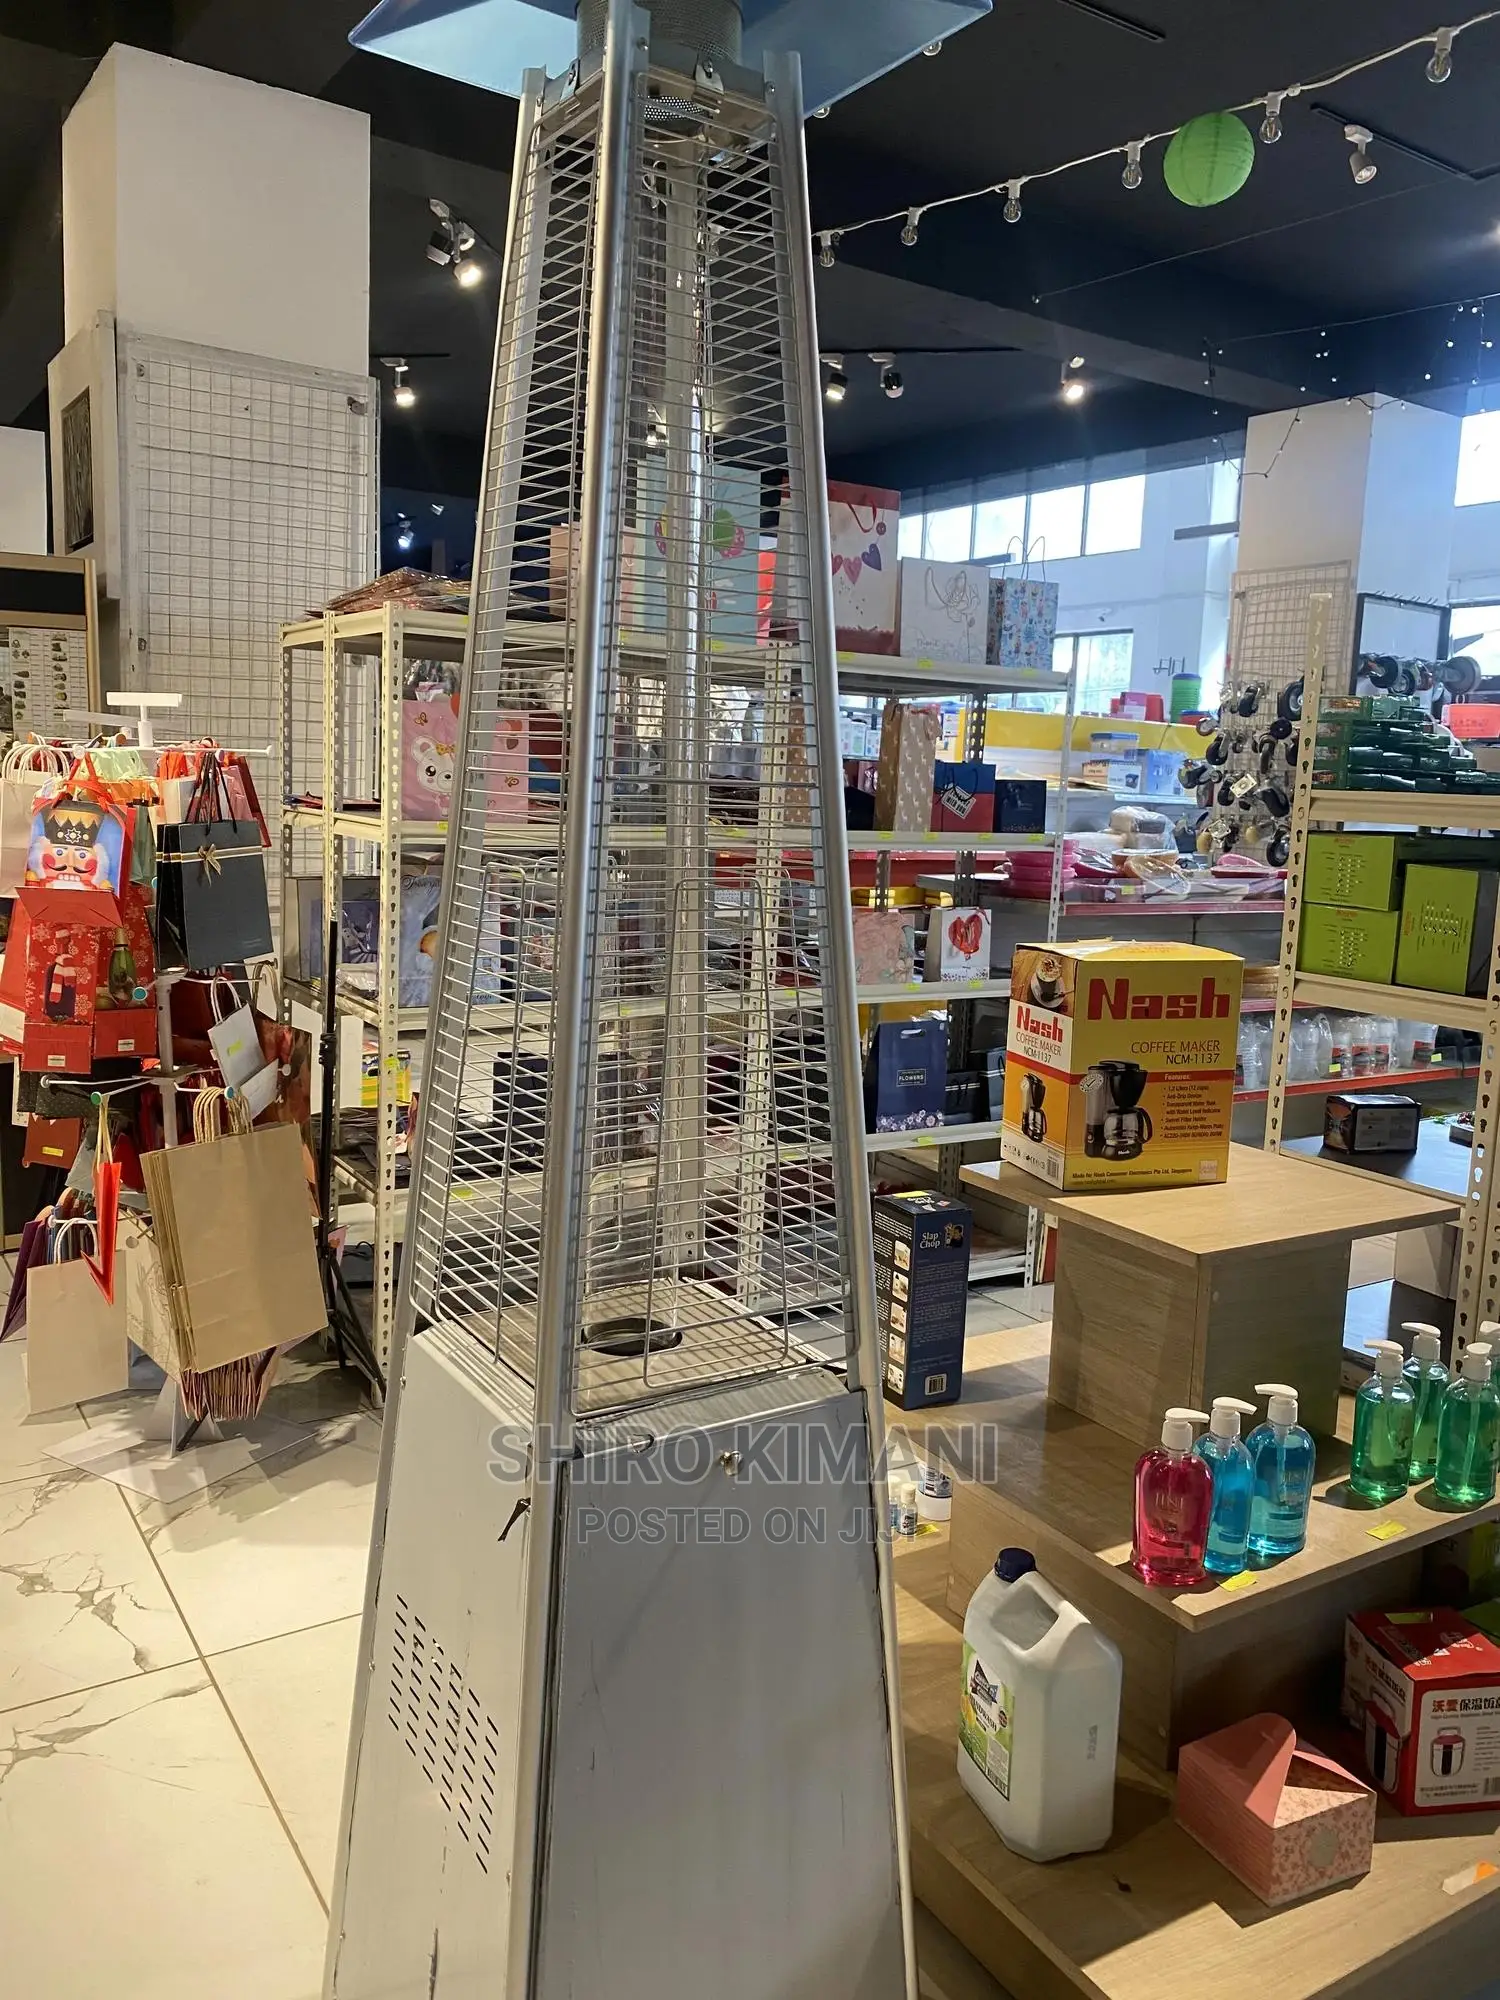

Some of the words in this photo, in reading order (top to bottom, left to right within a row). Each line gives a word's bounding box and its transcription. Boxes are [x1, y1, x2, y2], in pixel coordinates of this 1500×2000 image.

[1087, 976, 1231, 1021] Nash
[1016, 1005, 1063, 1043] Nash
[1015, 1031, 1038, 1049] COFFEE
[1039, 1039, 1062, 1057] MAKER
[1131, 1041, 1177, 1054] COFFEE
[1180, 1039, 1220, 1053] MAKER
[1023, 1045, 1052, 1064] NCM-1137
[1166, 1053, 1220, 1065] NCM-1137
[919, 1240, 941, 1249] Chop
[922, 1231, 939, 1241] Slap
